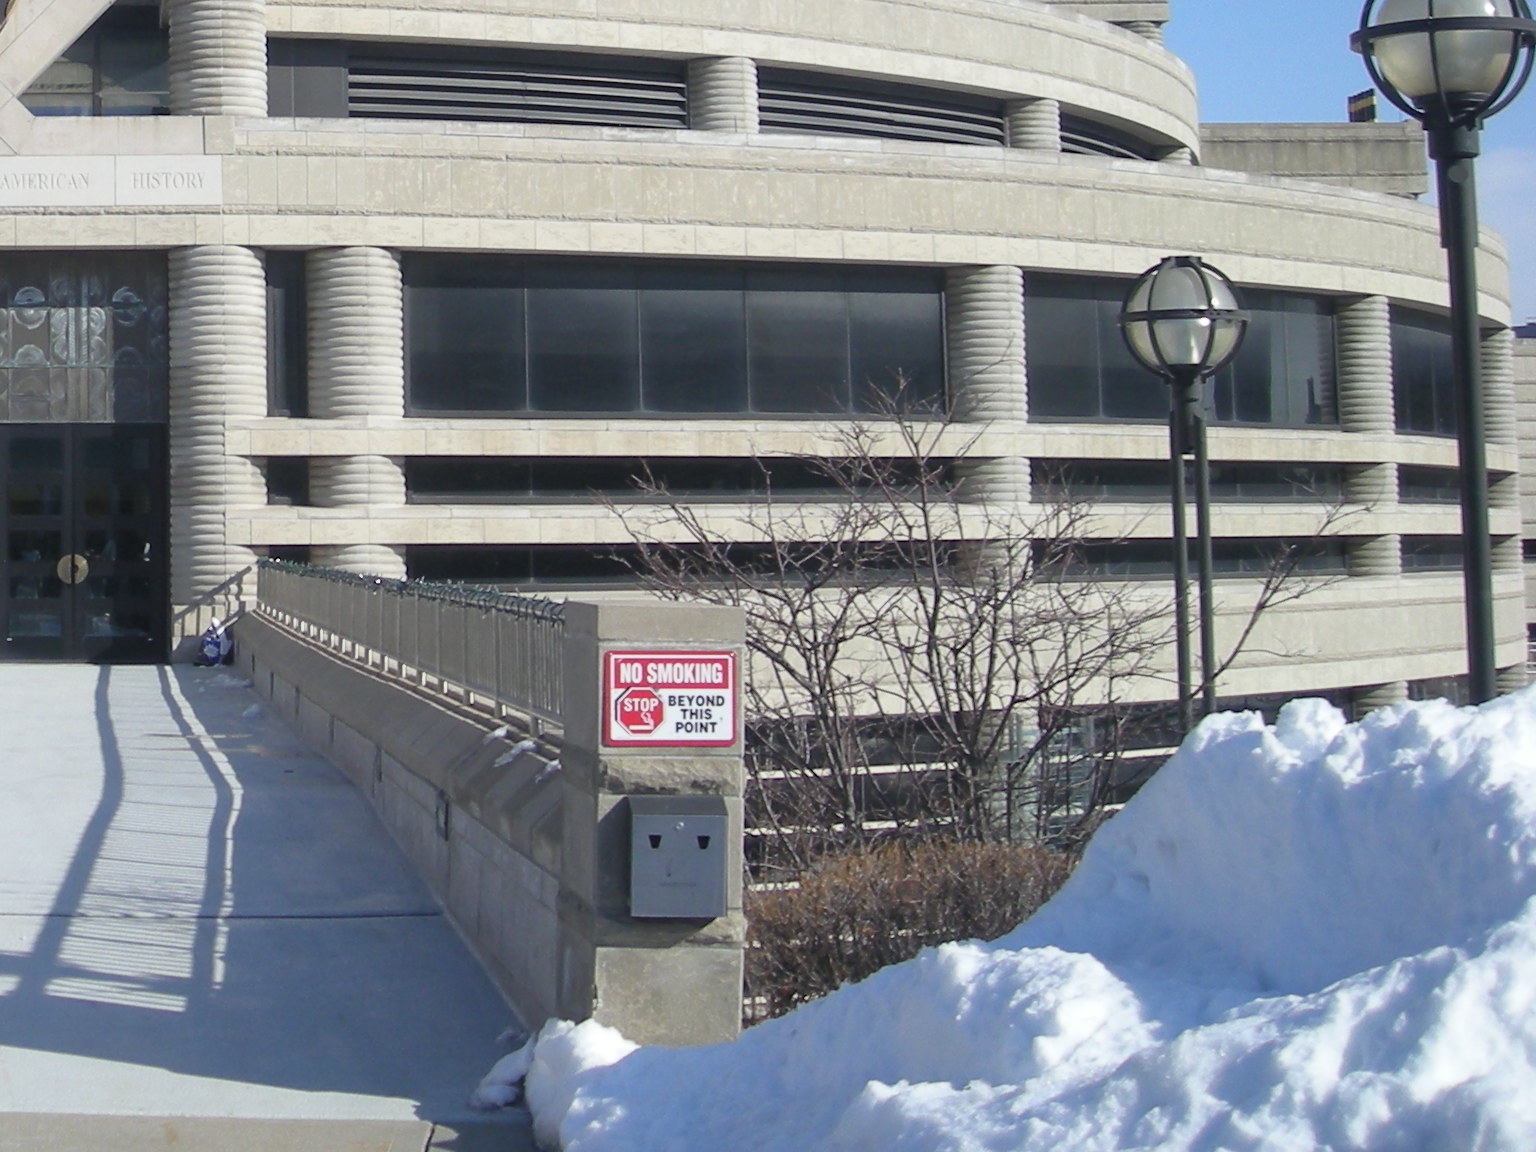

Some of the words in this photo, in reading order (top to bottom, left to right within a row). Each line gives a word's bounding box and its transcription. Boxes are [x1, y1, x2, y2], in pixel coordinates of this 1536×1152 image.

[0, 172, 90, 190] AMERICAN
[131, 171, 205, 189] HISTORY
[620, 662, 642, 683] NO
[646, 662, 723, 684] SMOKING
[623, 697, 659, 712] STOP
[668, 695, 724, 707] BEYOND
[681, 708, 712, 720] THIS
[675, 721, 717, 733] POINT
